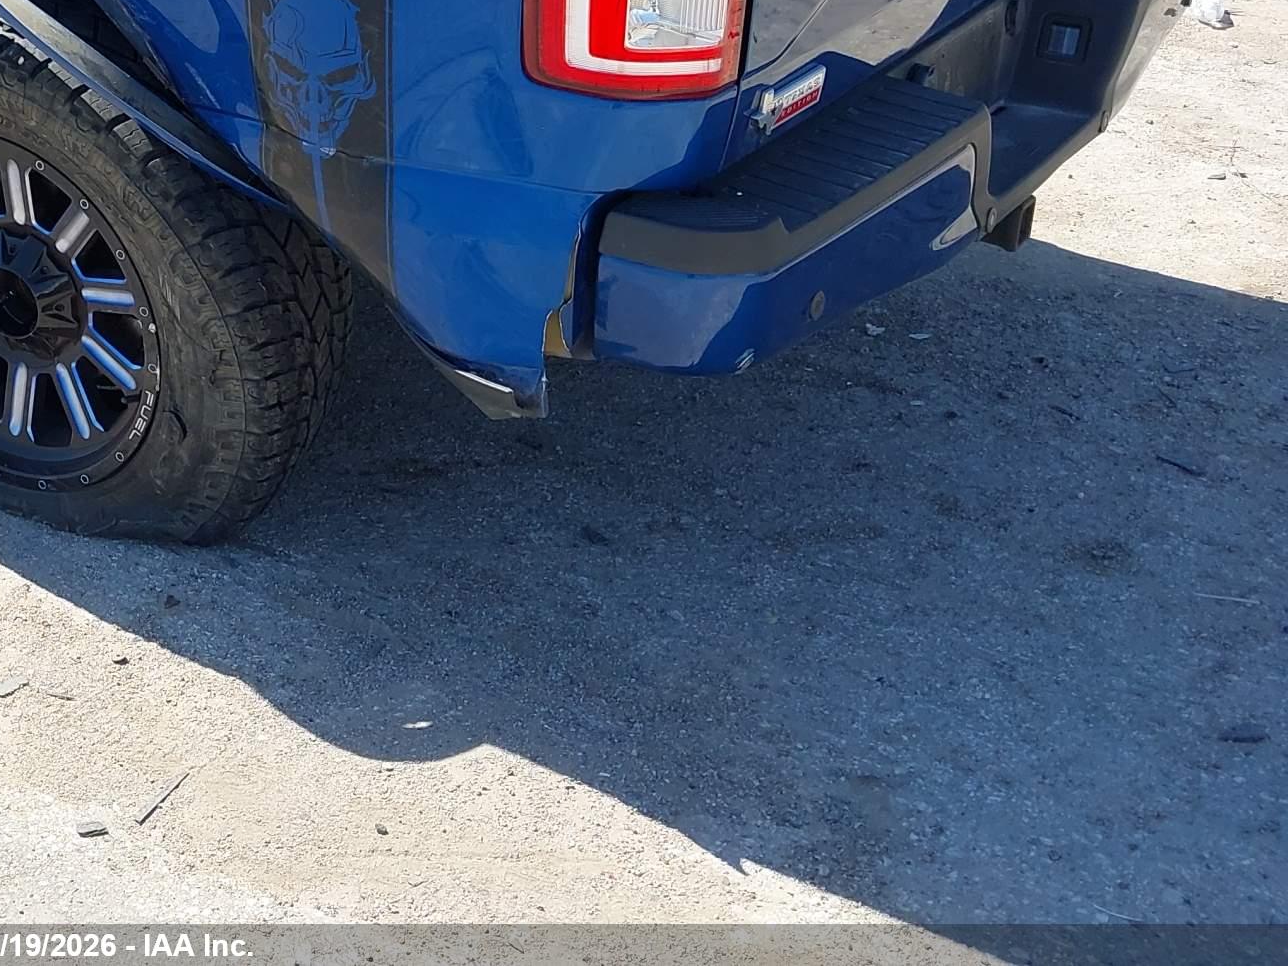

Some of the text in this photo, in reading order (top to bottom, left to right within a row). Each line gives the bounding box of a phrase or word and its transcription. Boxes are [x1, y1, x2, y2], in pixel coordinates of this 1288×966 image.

[781, 90, 818, 117] EDITION
[784, 74, 821, 104] TEXAS
[128, 389, 155, 440] FUEL
